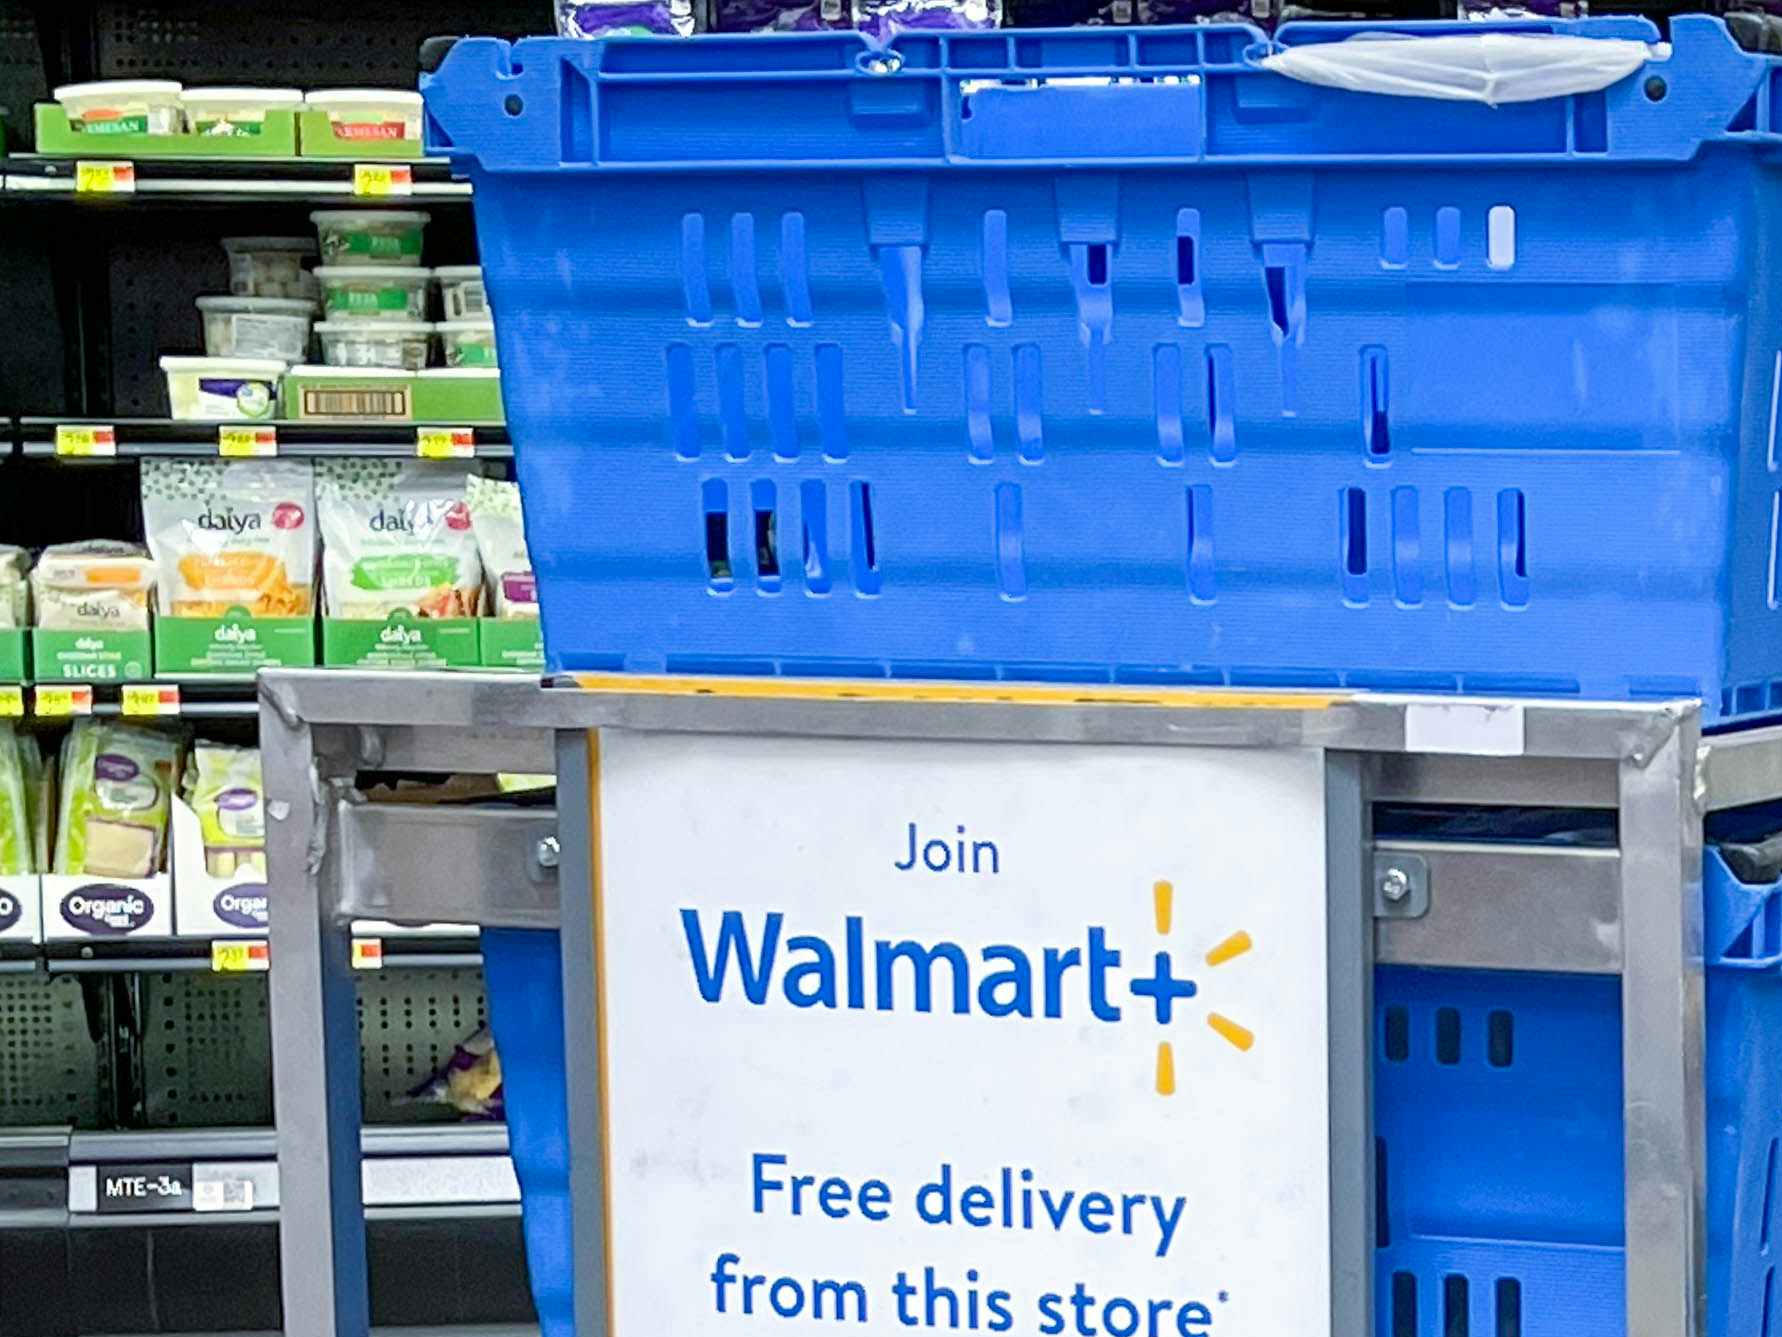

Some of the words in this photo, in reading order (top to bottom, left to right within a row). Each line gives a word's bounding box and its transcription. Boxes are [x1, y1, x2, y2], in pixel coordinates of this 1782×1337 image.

[198, 507, 262, 535] daiya
[214, 623, 257, 645] daiya
[62, 663, 117, 678] SLICES
[894, 822, 1000, 875] Join
[68, 894, 145, 919] Organic
[678, 906, 1199, 1025] Walmart+
[105, 1174, 183, 1198] MTE-3a
[751, 1152, 893, 1223] Free
[915, 1163, 1188, 1257] delivery
[709, 1252, 869, 1324] from
[892, 1266, 1015, 1333] this
